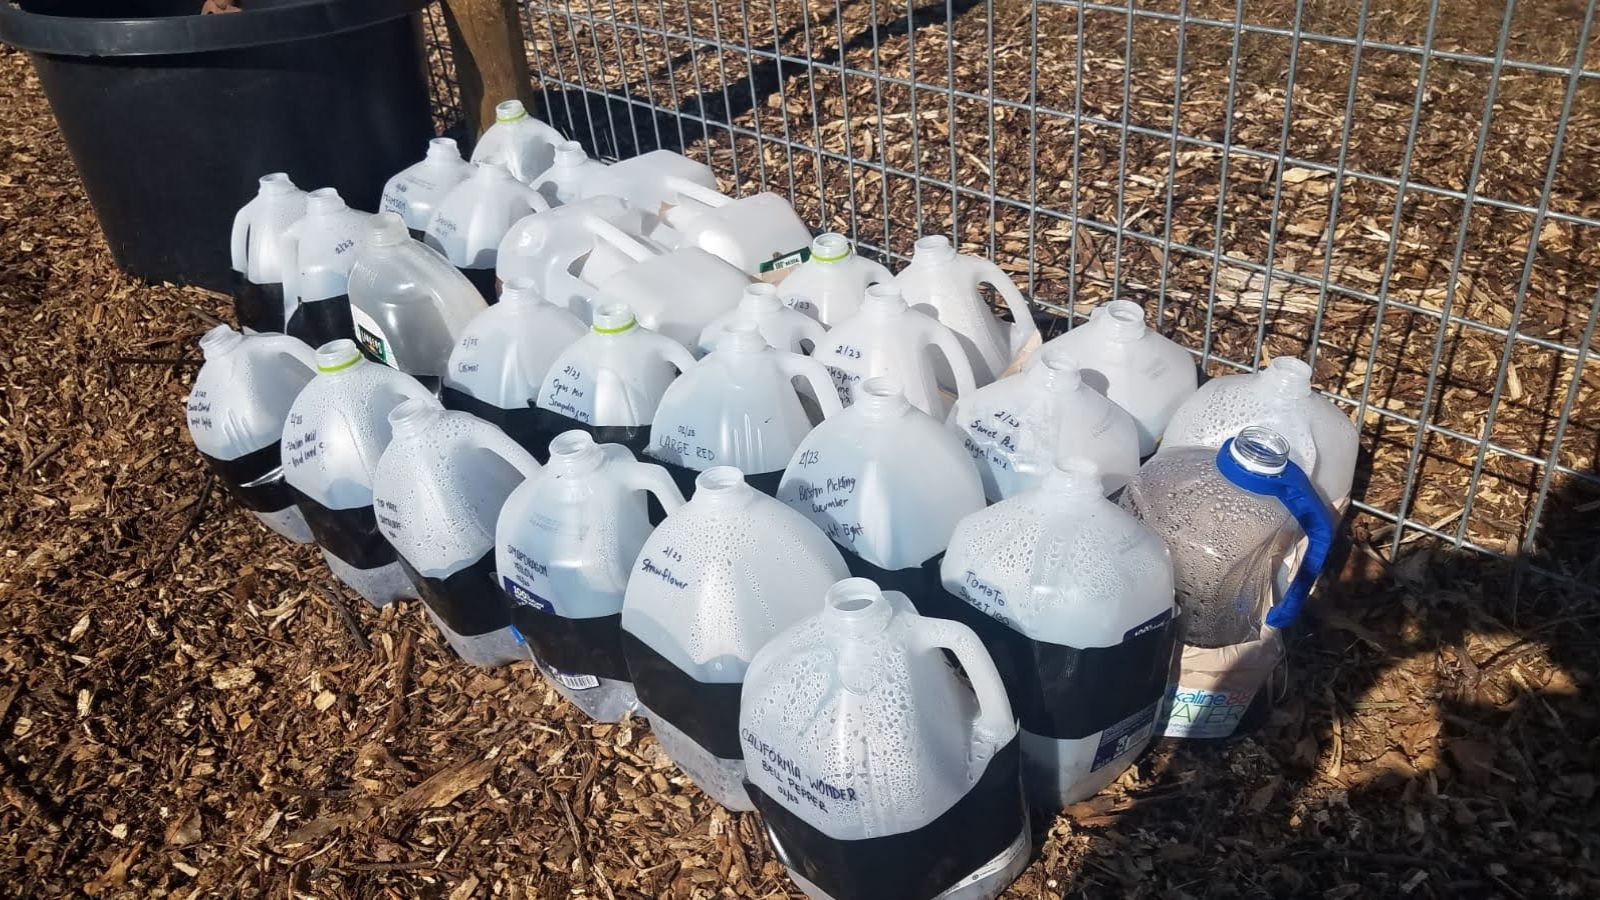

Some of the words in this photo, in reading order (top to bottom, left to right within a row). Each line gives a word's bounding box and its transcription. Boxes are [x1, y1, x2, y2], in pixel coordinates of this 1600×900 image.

[836, 344, 861, 359] 2/23
[563, 365, 581, 381] 2/23
[659, 434, 690, 456] LARGE
[696, 446, 715, 461] RED
[798, 449, 820, 469] 2/23
[641, 558, 689, 590] Strawflower
[741, 728, 802, 781] CALIFORNIA
[808, 775, 857, 802] WONDER
[761, 759, 783, 783] BELL
[788, 779, 829, 814] PEPPER
